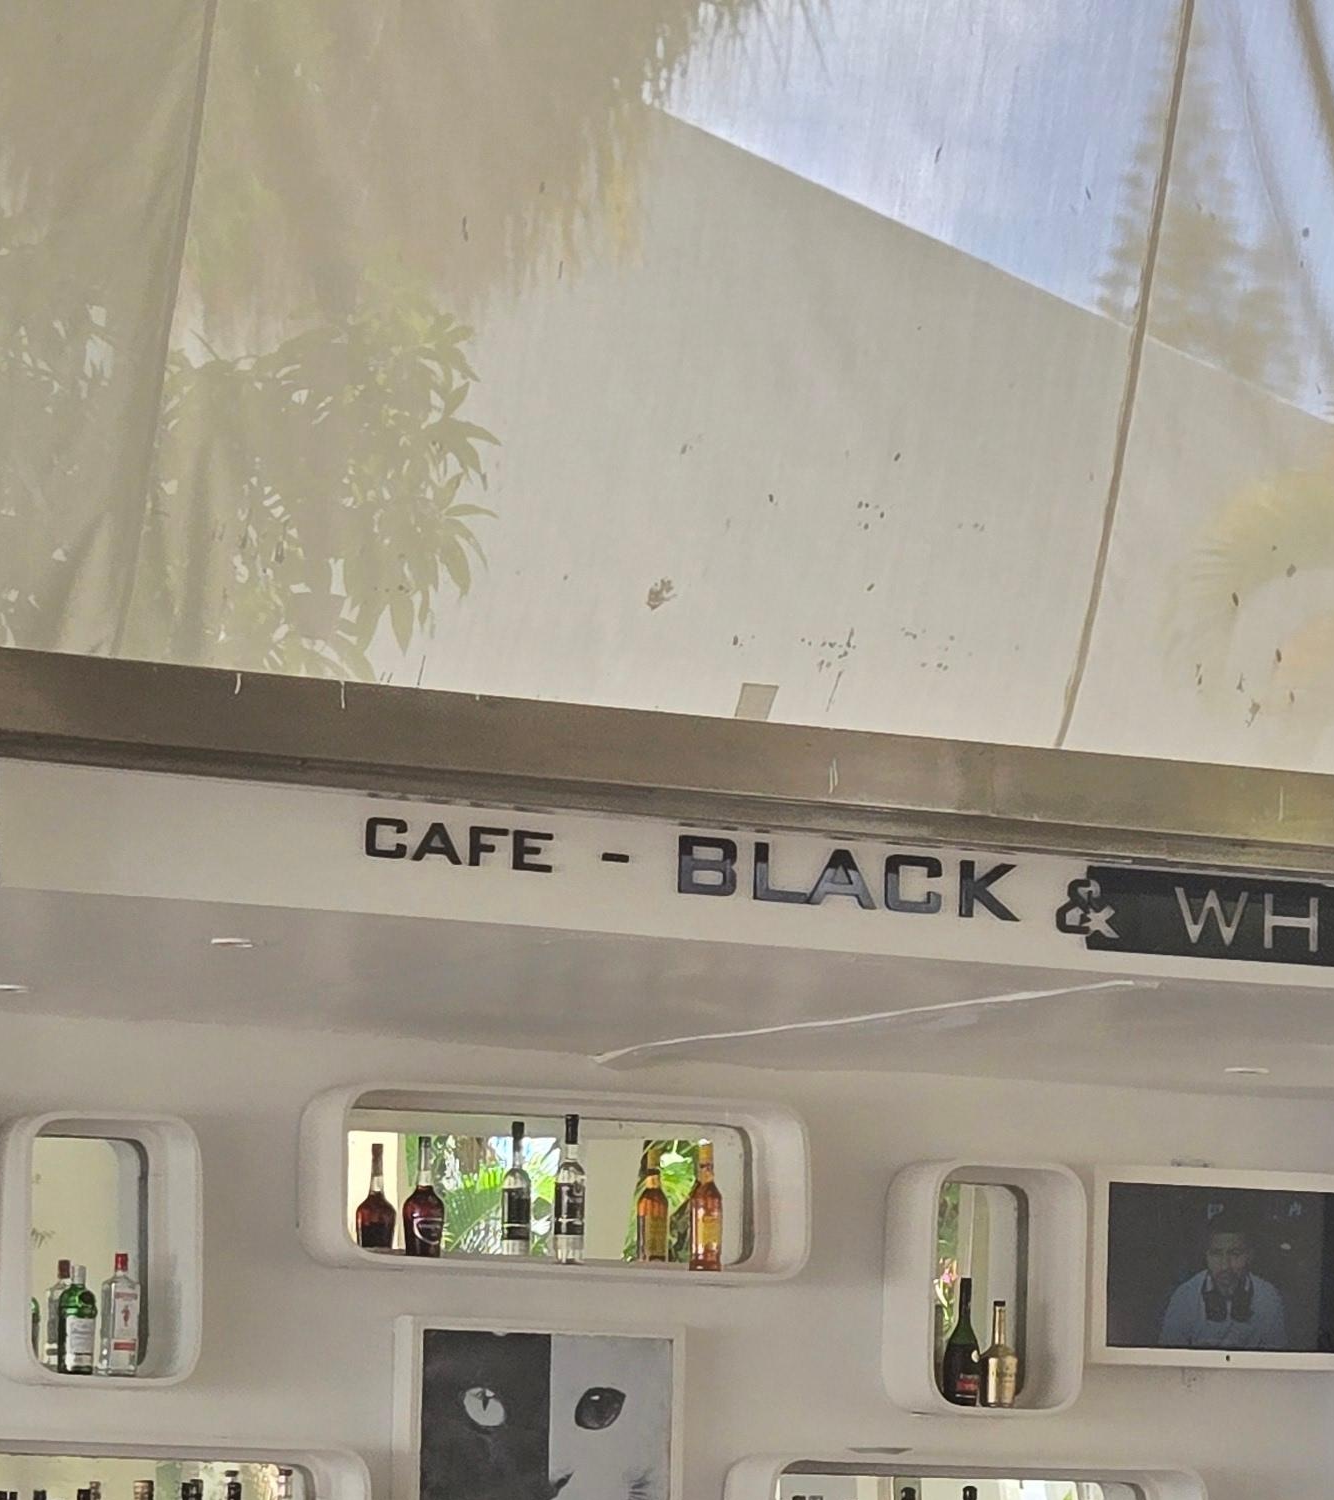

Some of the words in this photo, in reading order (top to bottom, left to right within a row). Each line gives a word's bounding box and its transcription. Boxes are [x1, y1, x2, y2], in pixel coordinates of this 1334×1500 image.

[365, 816, 555, 874] CAFE
[677, 834, 1021, 923] BLACK
[1055, 878, 1121, 940] &
